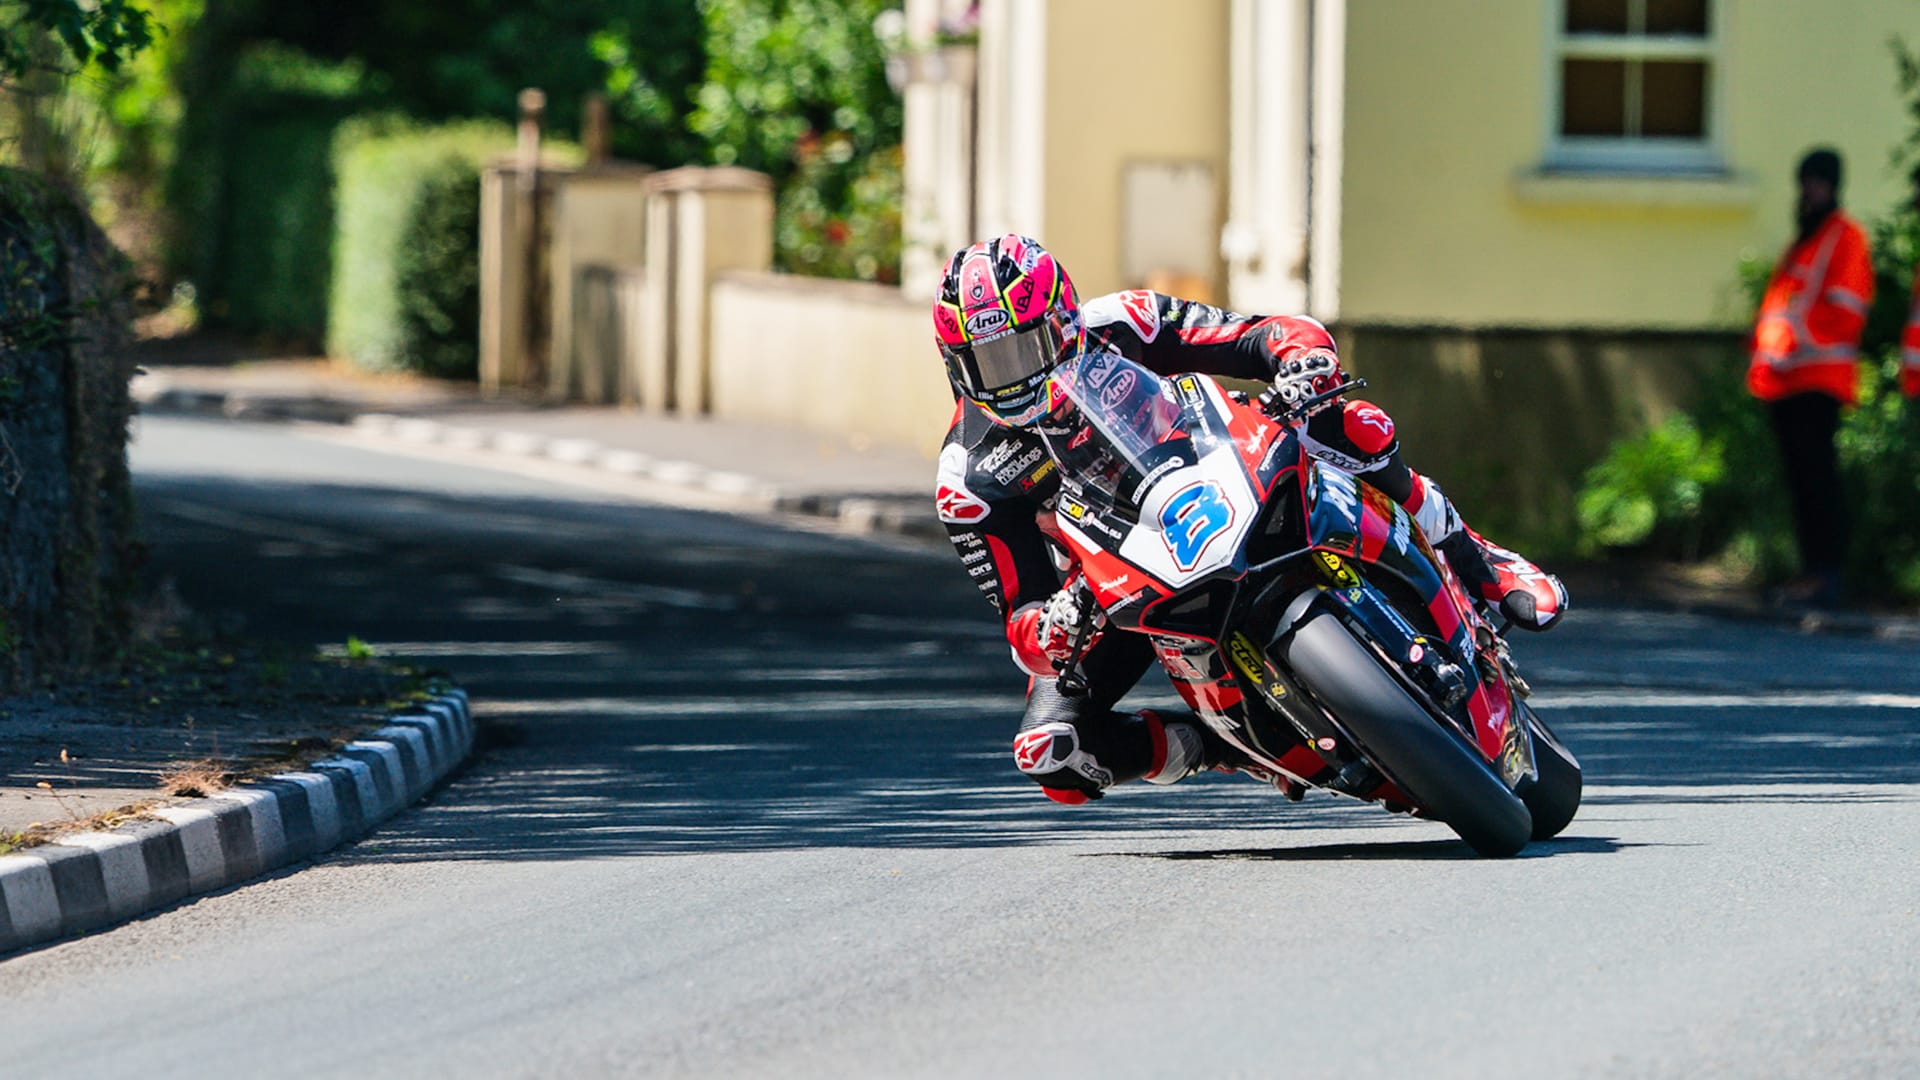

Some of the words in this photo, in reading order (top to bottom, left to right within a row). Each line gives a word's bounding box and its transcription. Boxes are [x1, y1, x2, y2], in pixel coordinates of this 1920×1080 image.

[966, 309, 1007, 334] Arai
[1103, 370, 1133, 407] Arai
[1160, 481, 1234, 569] 8
